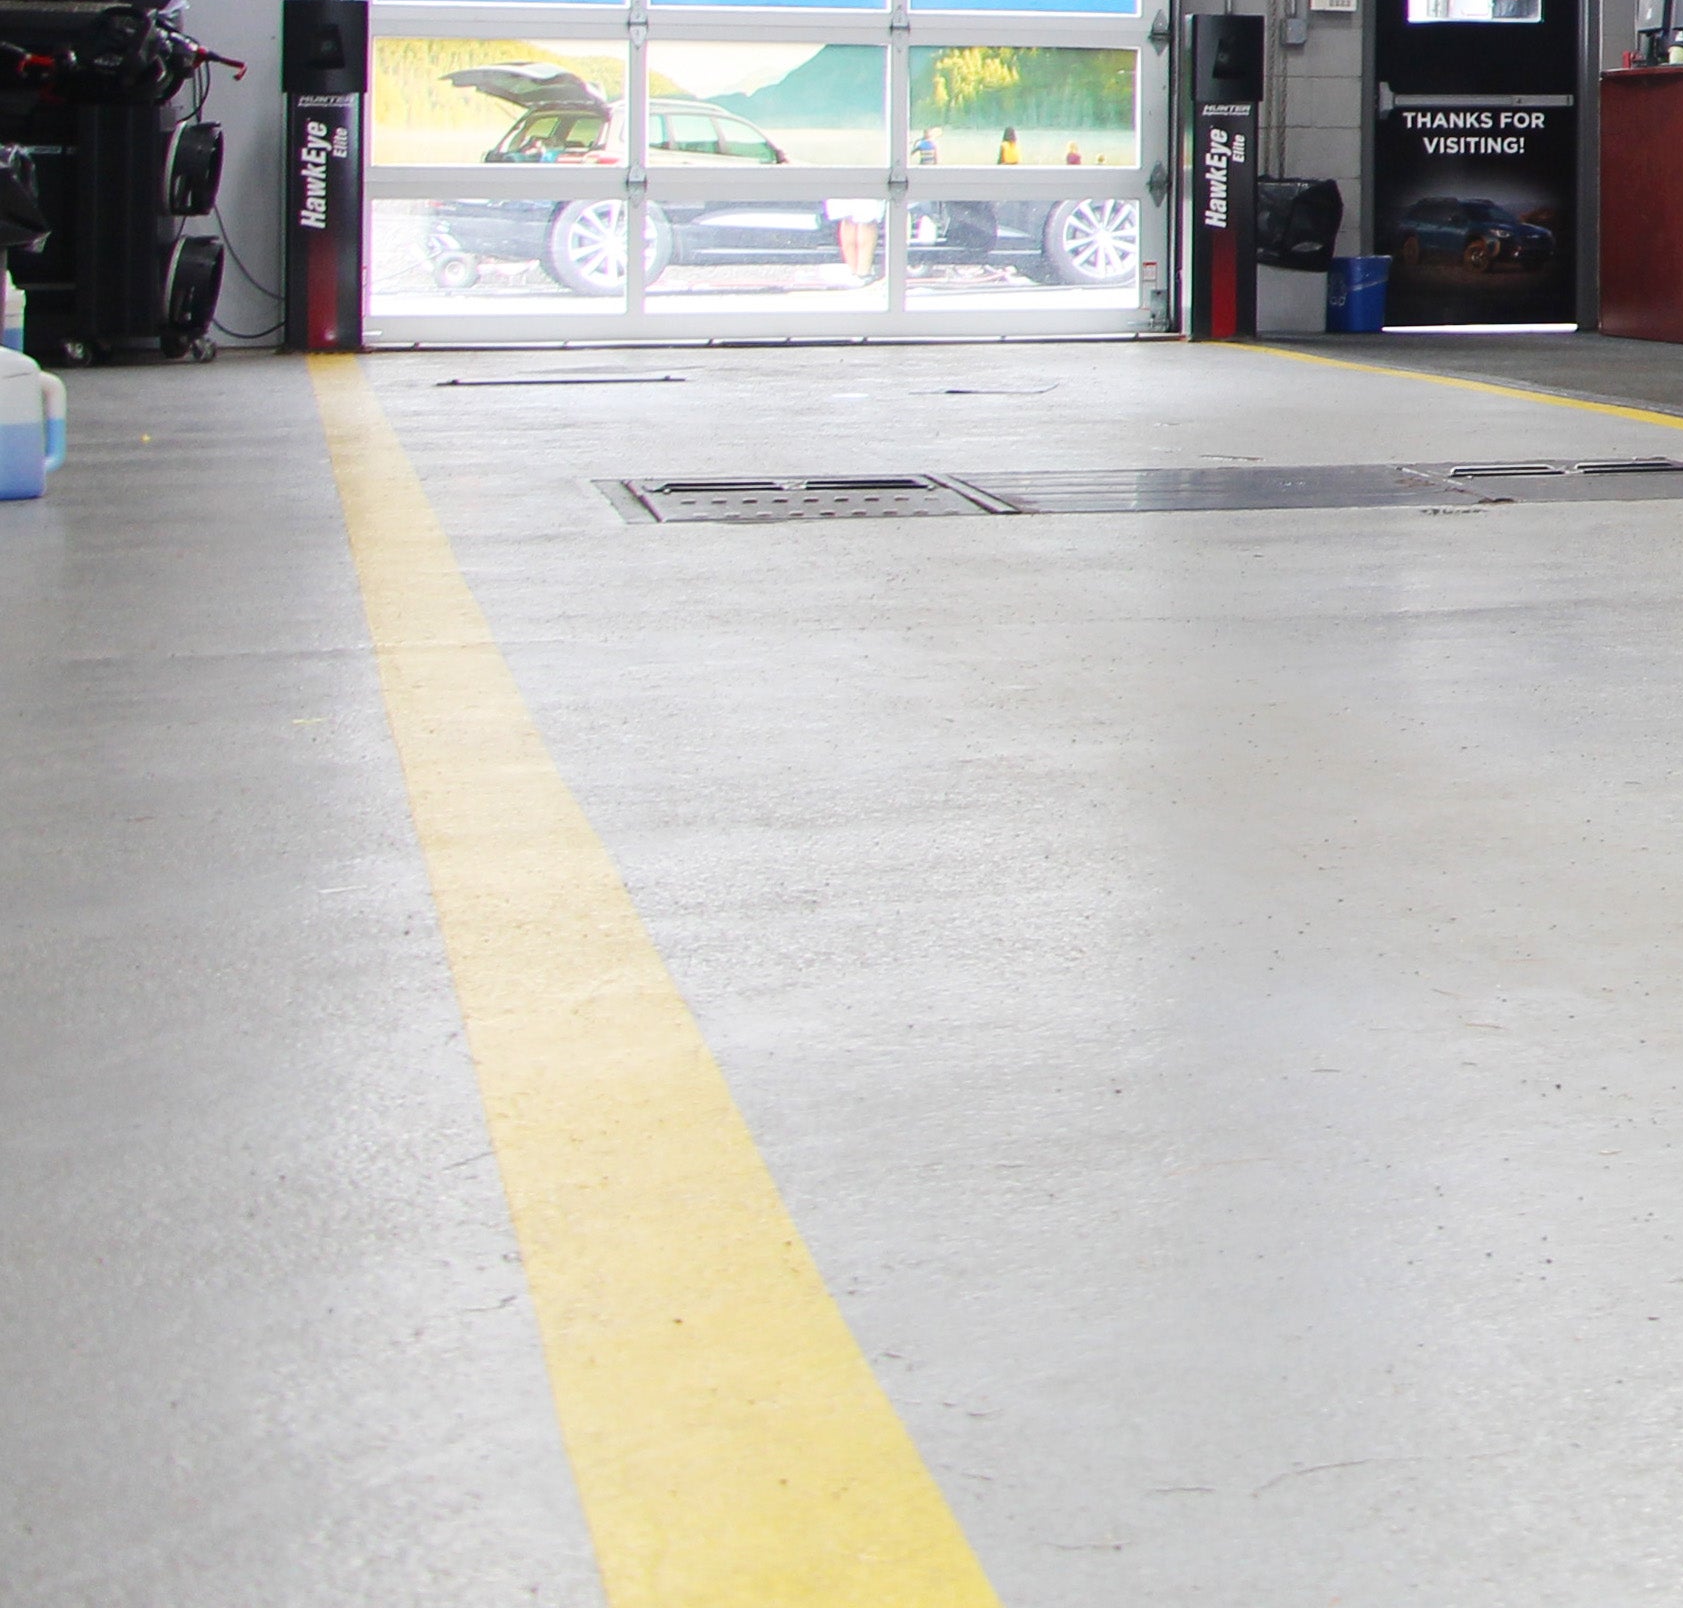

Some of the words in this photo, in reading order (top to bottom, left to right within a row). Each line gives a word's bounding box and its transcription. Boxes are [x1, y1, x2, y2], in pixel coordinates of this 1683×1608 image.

[1203, 104, 1251, 112] HUNTER
[1403, 112, 1493, 129] THANKS
[1500, 112, 1545, 129] FOR
[332, 126, 348, 158] Elite
[1232, 133, 1245, 163] Elite
[1423, 136, 1525, 154] VISITING!
[300, 120, 332, 229] HawkEye
[1205, 127, 1232, 228] HawkEye
